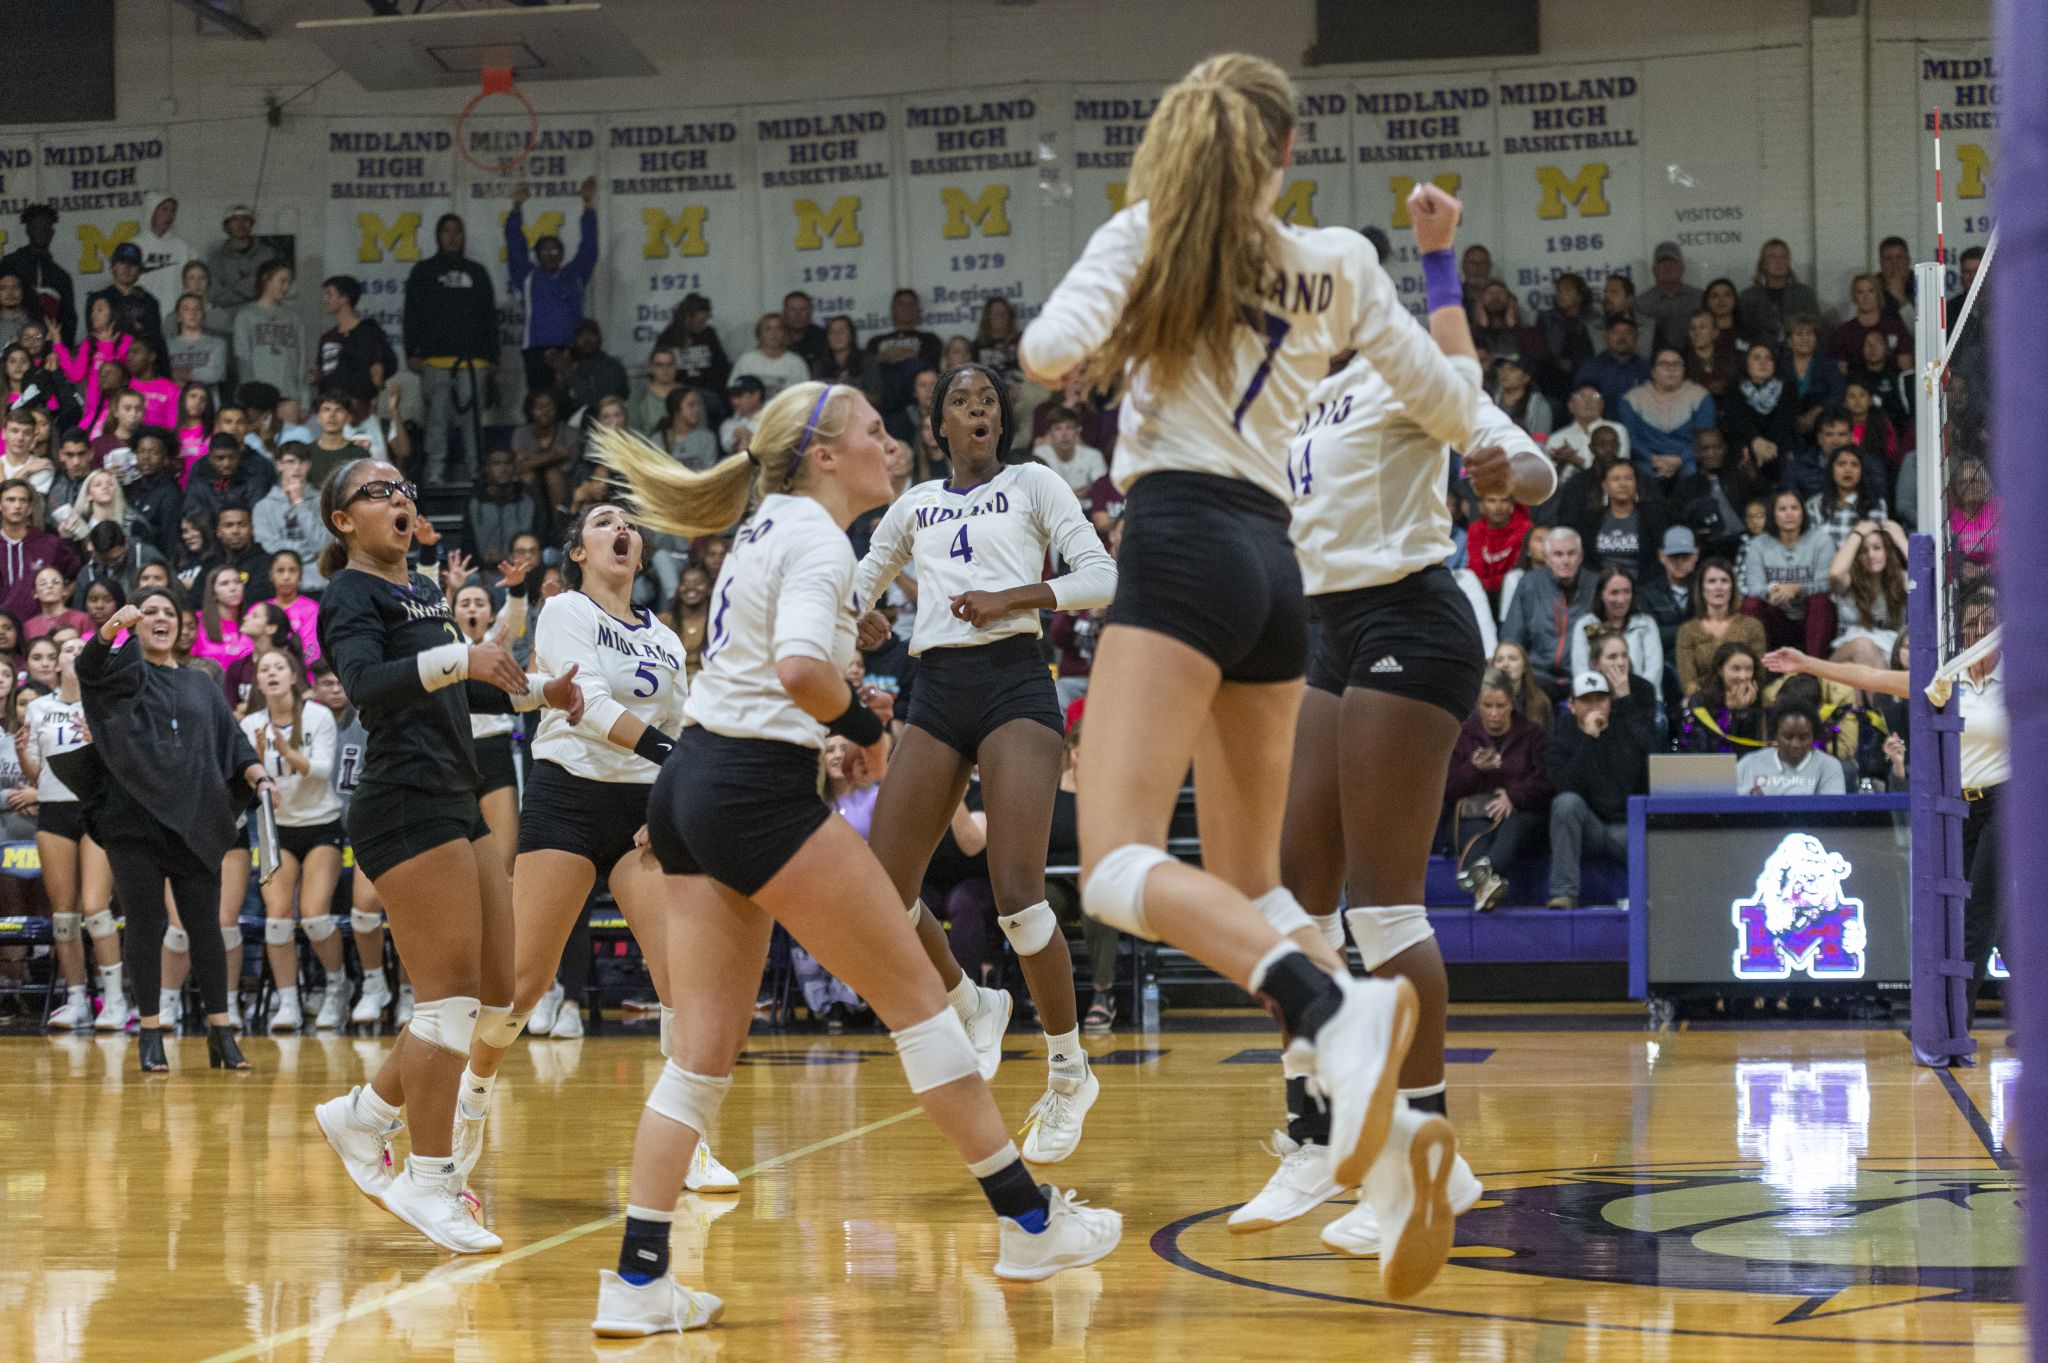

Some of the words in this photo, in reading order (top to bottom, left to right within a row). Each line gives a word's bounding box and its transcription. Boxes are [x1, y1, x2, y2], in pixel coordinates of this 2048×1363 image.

[1923, 57, 1998, 81] MIDL
[1356, 87, 1490, 115] MIDLAND
[1500, 75, 1638, 106] MIDLAND
[907, 99, 1036, 128] MIDLAND
[1075, 98, 1157, 121] MIDL
[1533, 105, 1608, 131] HIGH
[610, 122, 737, 147] MIDLAND
[757, 111, 887, 141] MIDLAND
[936, 126, 1007, 151] HIGH
[1387, 115, 1461, 140] HIGH
[44, 139, 163, 166] MIDLAND
[329, 130, 452, 152] MIDLAND
[470, 129, 595, 152] MIDLAND
[788, 139, 860, 165] HIGH
[1359, 140, 1490, 164] BASKETBALL
[1503, 129, 1639, 155] BASKETBALL
[357, 156, 425, 178] HIGH
[639, 149, 708, 173] HIGH
[909, 151, 1037, 176] BASKETBALL
[72, 166, 137, 190] HIGH
[612, 174, 736, 195] BASKETBALL
[762, 162, 889, 189] BASKETBALL
[48, 189, 150, 212] BASKETBA
[331, 181, 452, 200] BASKETBALL
[1675, 205, 1744, 222] VISITORS
[1545, 234, 1605, 254] 1986
[1677, 229, 1743, 247] SECTION
[803, 264, 859, 283] 1972
[950, 253, 1006, 273] 1979
[650, 273, 702, 291] 1971
[932, 281, 1023, 306] Regional
[916, 491, 1010, 532] MIDLAND
[949, 523, 974, 564] 4
[596, 624, 680, 672] MIDLAND
[633, 660, 659, 698] 5
